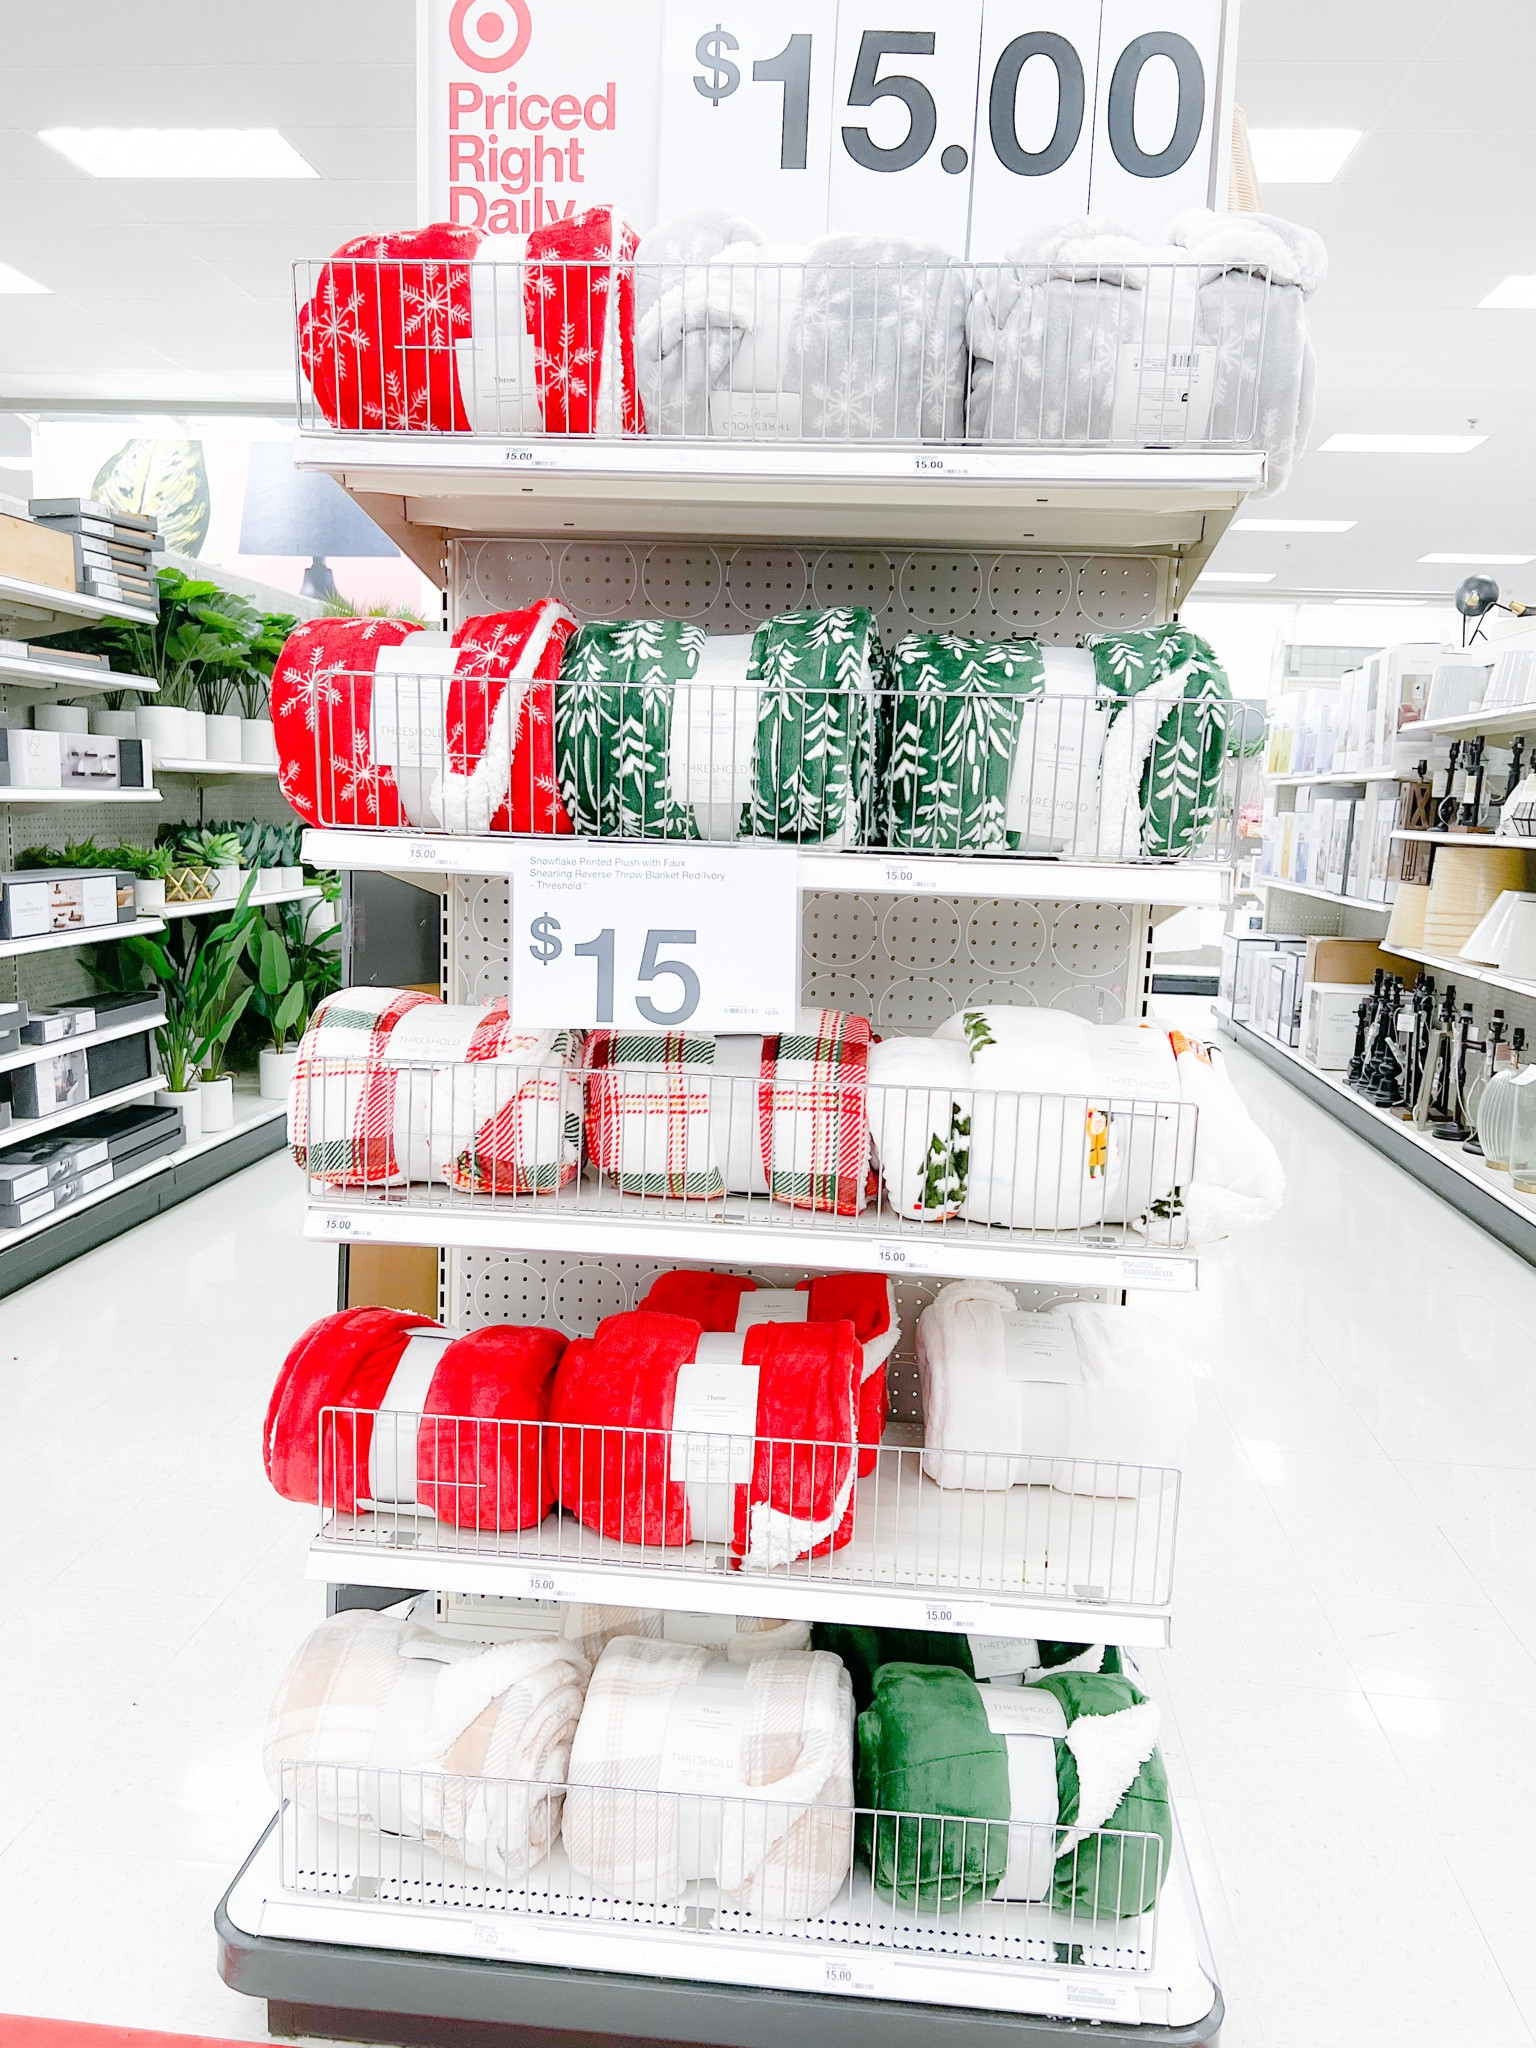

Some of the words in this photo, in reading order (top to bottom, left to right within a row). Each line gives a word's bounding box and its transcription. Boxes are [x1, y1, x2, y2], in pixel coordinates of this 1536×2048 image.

[449, 81, 616, 131] Priced
[693, 23, 1206, 177] $15.00
[449, 134, 585, 195] Right
[504, 452, 533, 461] 15.00
[914, 460, 944, 469] 15.00
[409, 848, 437, 859] 15.00
[529, 855, 577, 866] Snowflake
[579, 857, 613, 867] Printed
[614, 857, 640, 867] Plush
[642, 858, 661, 867] with
[663, 858, 686, 868] Faux
[529, 868, 573, 880] Shearling
[574, 869, 612, 879] Reverse
[614, 869, 643, 880] Throw
[645, 870, 680, 880] Blanket
[681, 870, 726, 882] Red/Ivory
[885, 870, 913, 881] 15.00
[528, 911, 701, 1026] $15
[400, 1036, 461, 1046] THRESHOLD
[1105, 1075, 1171, 1090] THRESHOLD
[326, 1219, 352, 1230] 15.00
[879, 1251, 906, 1262] 15.00
[529, 1578, 555, 1590] 15.00
[926, 1610, 952, 1621] 15.00
[992, 1703, 1054, 1714] THRESHOLD
[672, 1752, 735, 1769] THRESHOLD
[825, 1969, 852, 1982] 15.00
